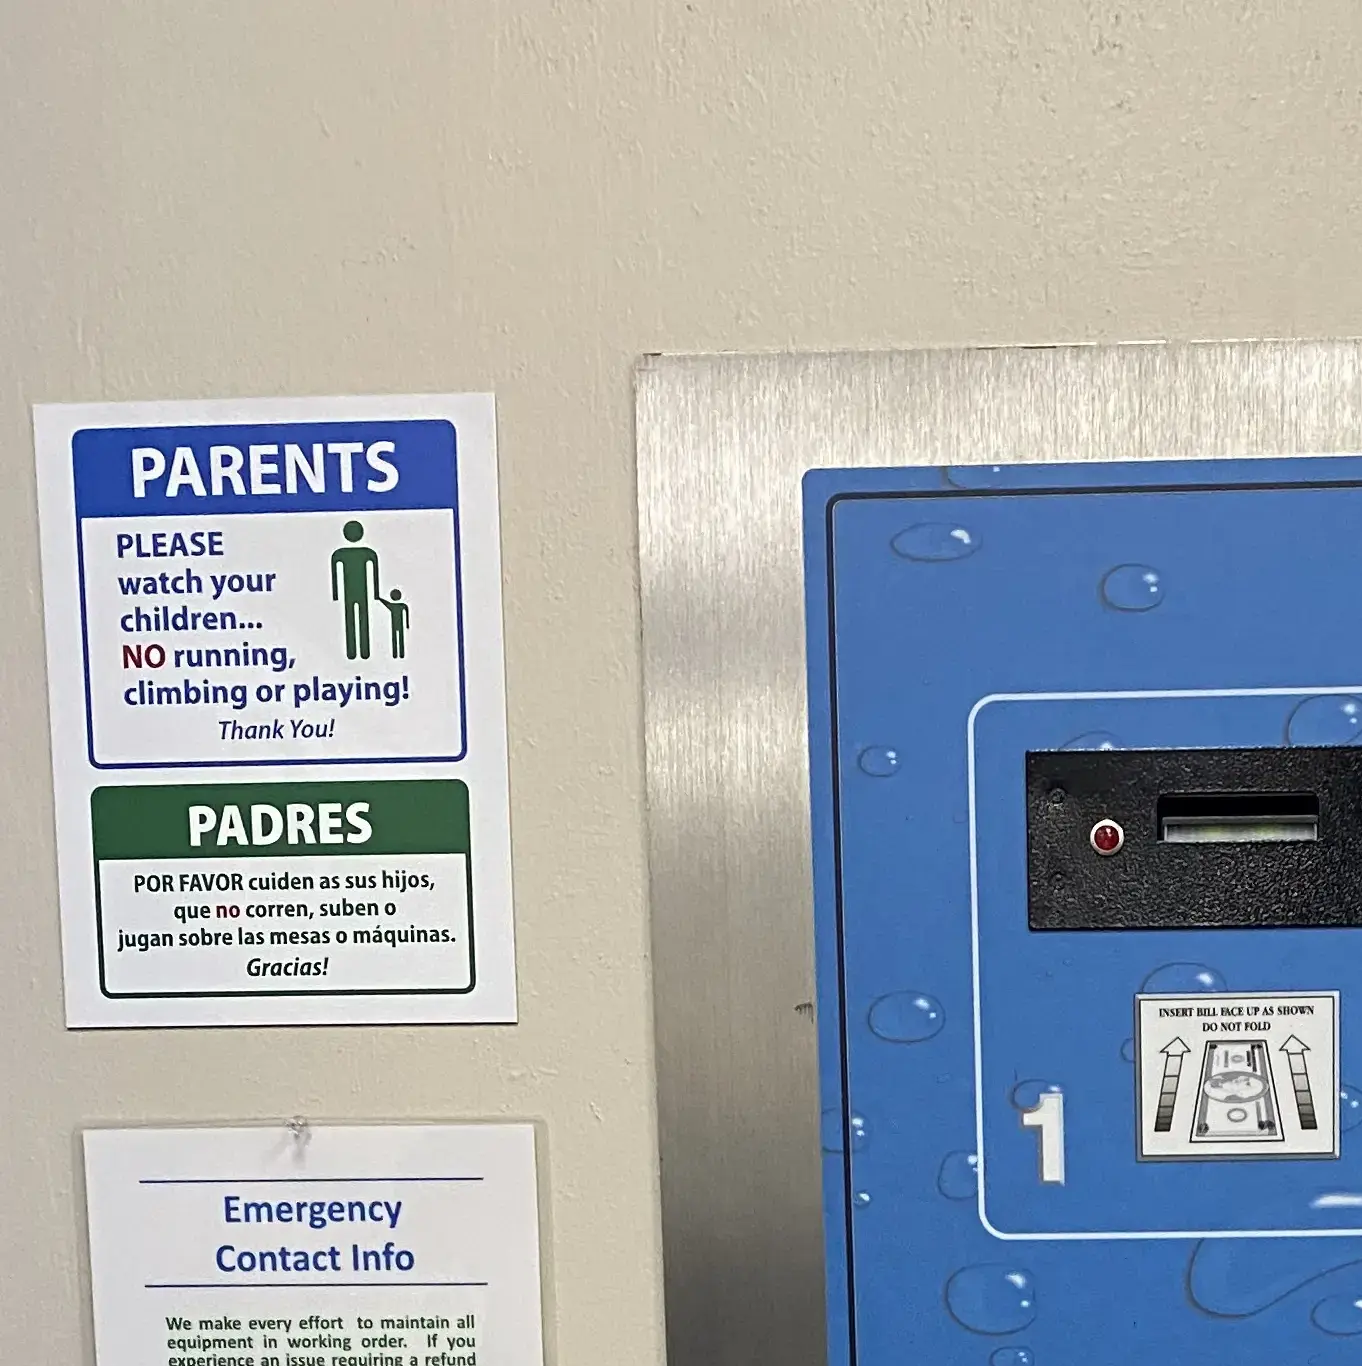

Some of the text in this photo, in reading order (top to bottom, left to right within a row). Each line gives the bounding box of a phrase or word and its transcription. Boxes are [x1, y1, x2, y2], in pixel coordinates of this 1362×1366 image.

[132, 441, 398, 497] PARENTS
[117, 532, 223, 558] PLEASE
[118, 568, 276, 600] watch your
[121, 606, 262, 632] children...
[123, 642, 295, 672] NO running,
[124, 676, 408, 709] climbing or playing!
[219, 719, 334, 739] Thank You!
[189, 802, 372, 846] PADRES
[135, 870, 434, 892] POR FAVOR cuiden as sus hijos,
[174, 898, 396, 923] que no corren, suben o
[118, 925, 455, 952] jugan sobre las mesas o máquinas.
[247, 957, 328, 976] Gracias!
[1159, 1005, 1314, 1018] INSERT BILL FACE UP AS SHOWN
[1202, 1021, 1271, 1032] DO NOT FOLD
[1021, 1092, 1065, 1186] 1
[225, 1196, 401, 1229] Emergency
[217, 1242, 414, 1272] Contact Info
[166, 1315, 474, 1332] We make every effort to maintain all
[168, 1334, 475, 1352] equipment in working order. If you
[261, 1357, 279, 1366] an
[287, 1354, 324, 1366] issue
[410, 1356, 418, 1366] a
[426, 1352, 476, 1366] refund
